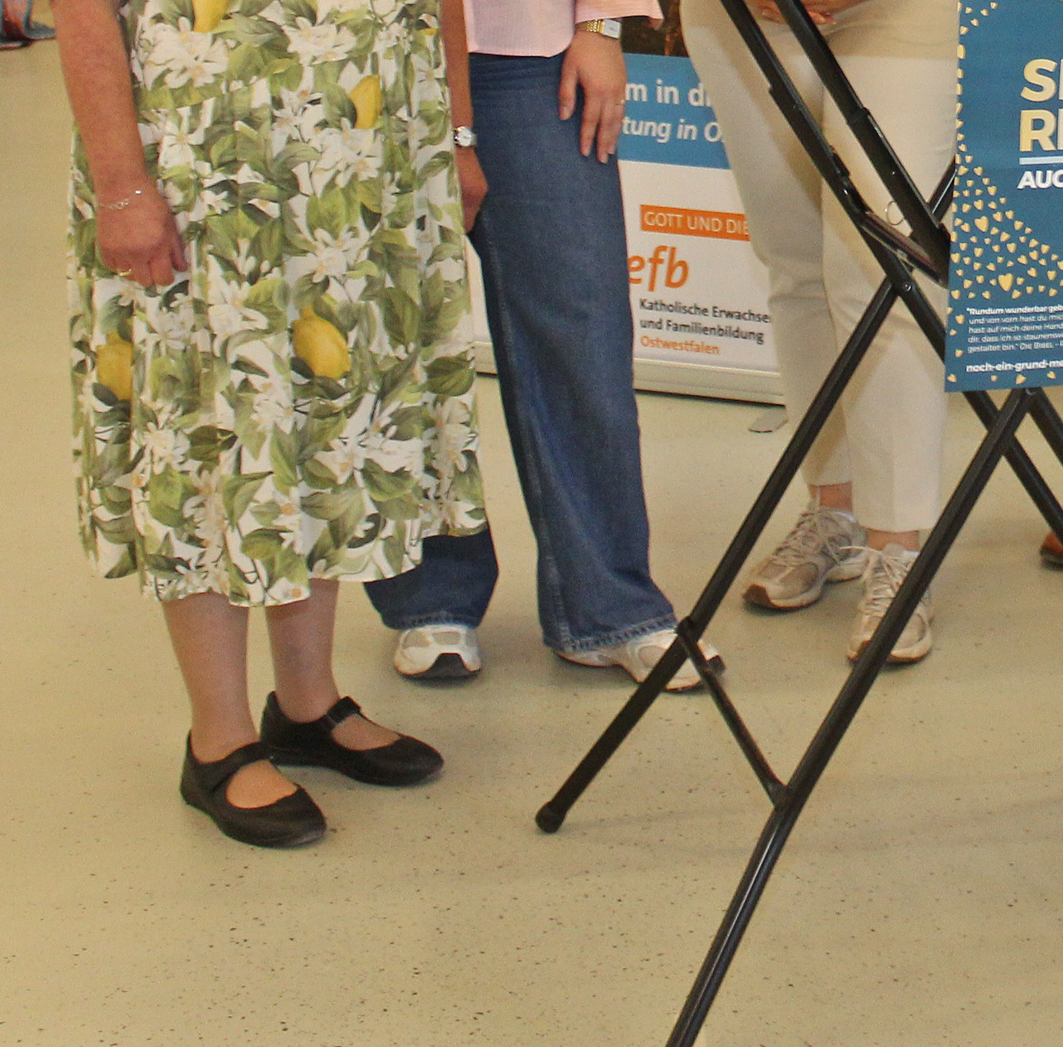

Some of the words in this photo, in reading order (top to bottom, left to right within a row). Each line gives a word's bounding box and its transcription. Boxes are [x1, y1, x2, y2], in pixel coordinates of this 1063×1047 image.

[656, 78, 680, 104] in
[622, 116, 673, 143] tung
[677, 118, 698, 140] in
[704, 122, 725, 142] O
[643, 211, 684, 229] GOTT
[686, 215, 723, 232] UND
[726, 219, 750, 235] DIE
[639, 298, 709, 317] Katholische
[711, 306, 772, 324] Erwachse
[969, 317, 984, 325] und
[1005, 305, 1047, 314] wunderbar
[639, 318, 663, 330] und
[665, 320, 765, 345] Familienbildung
[640, 335, 721, 355] Ostwestfalen
